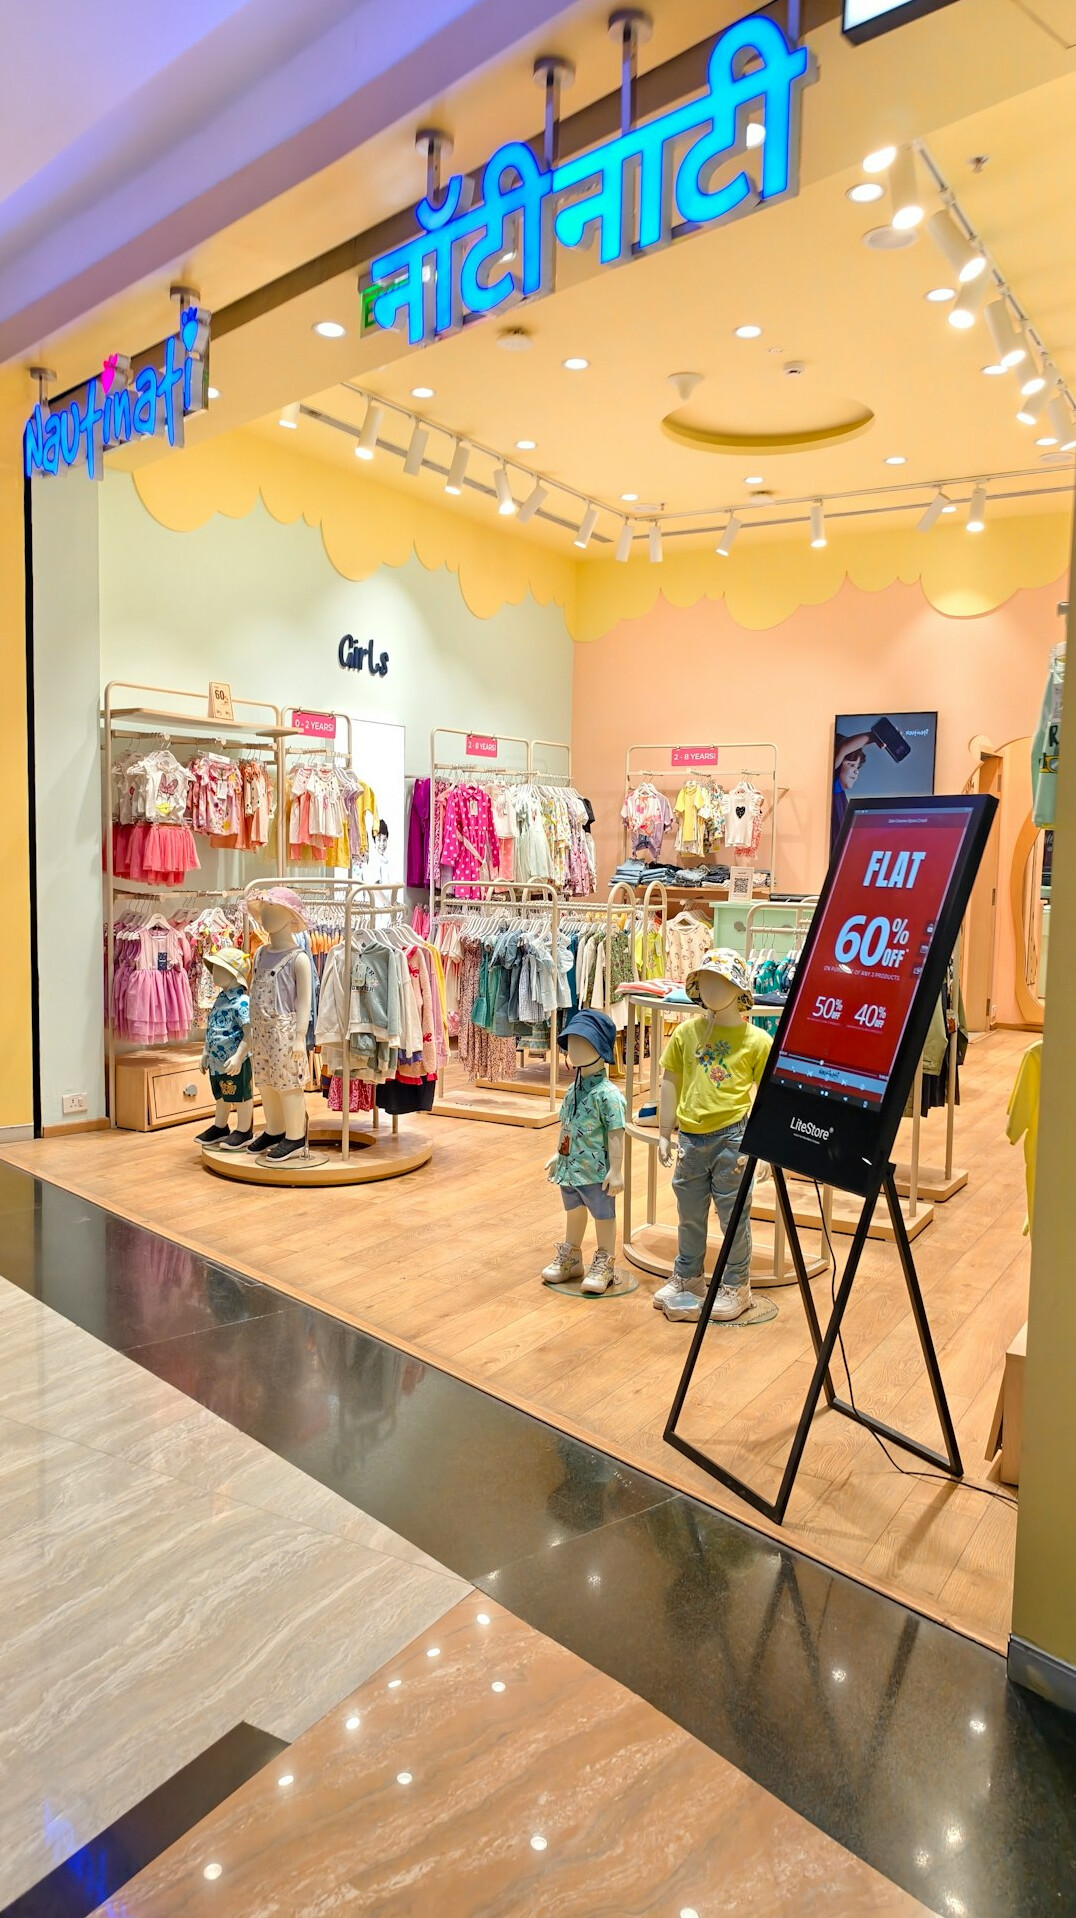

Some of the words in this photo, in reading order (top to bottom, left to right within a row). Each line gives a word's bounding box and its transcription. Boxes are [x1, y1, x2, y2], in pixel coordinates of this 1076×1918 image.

[371, 15, 808, 345] नॉटीनाटी
[23, 307, 199, 481] Nautinati
[338, 634, 389, 678] Girls
[294, 719, 300, 727] 0
[305, 720, 310, 729] 2
[863, 850, 927, 889] FLAT
